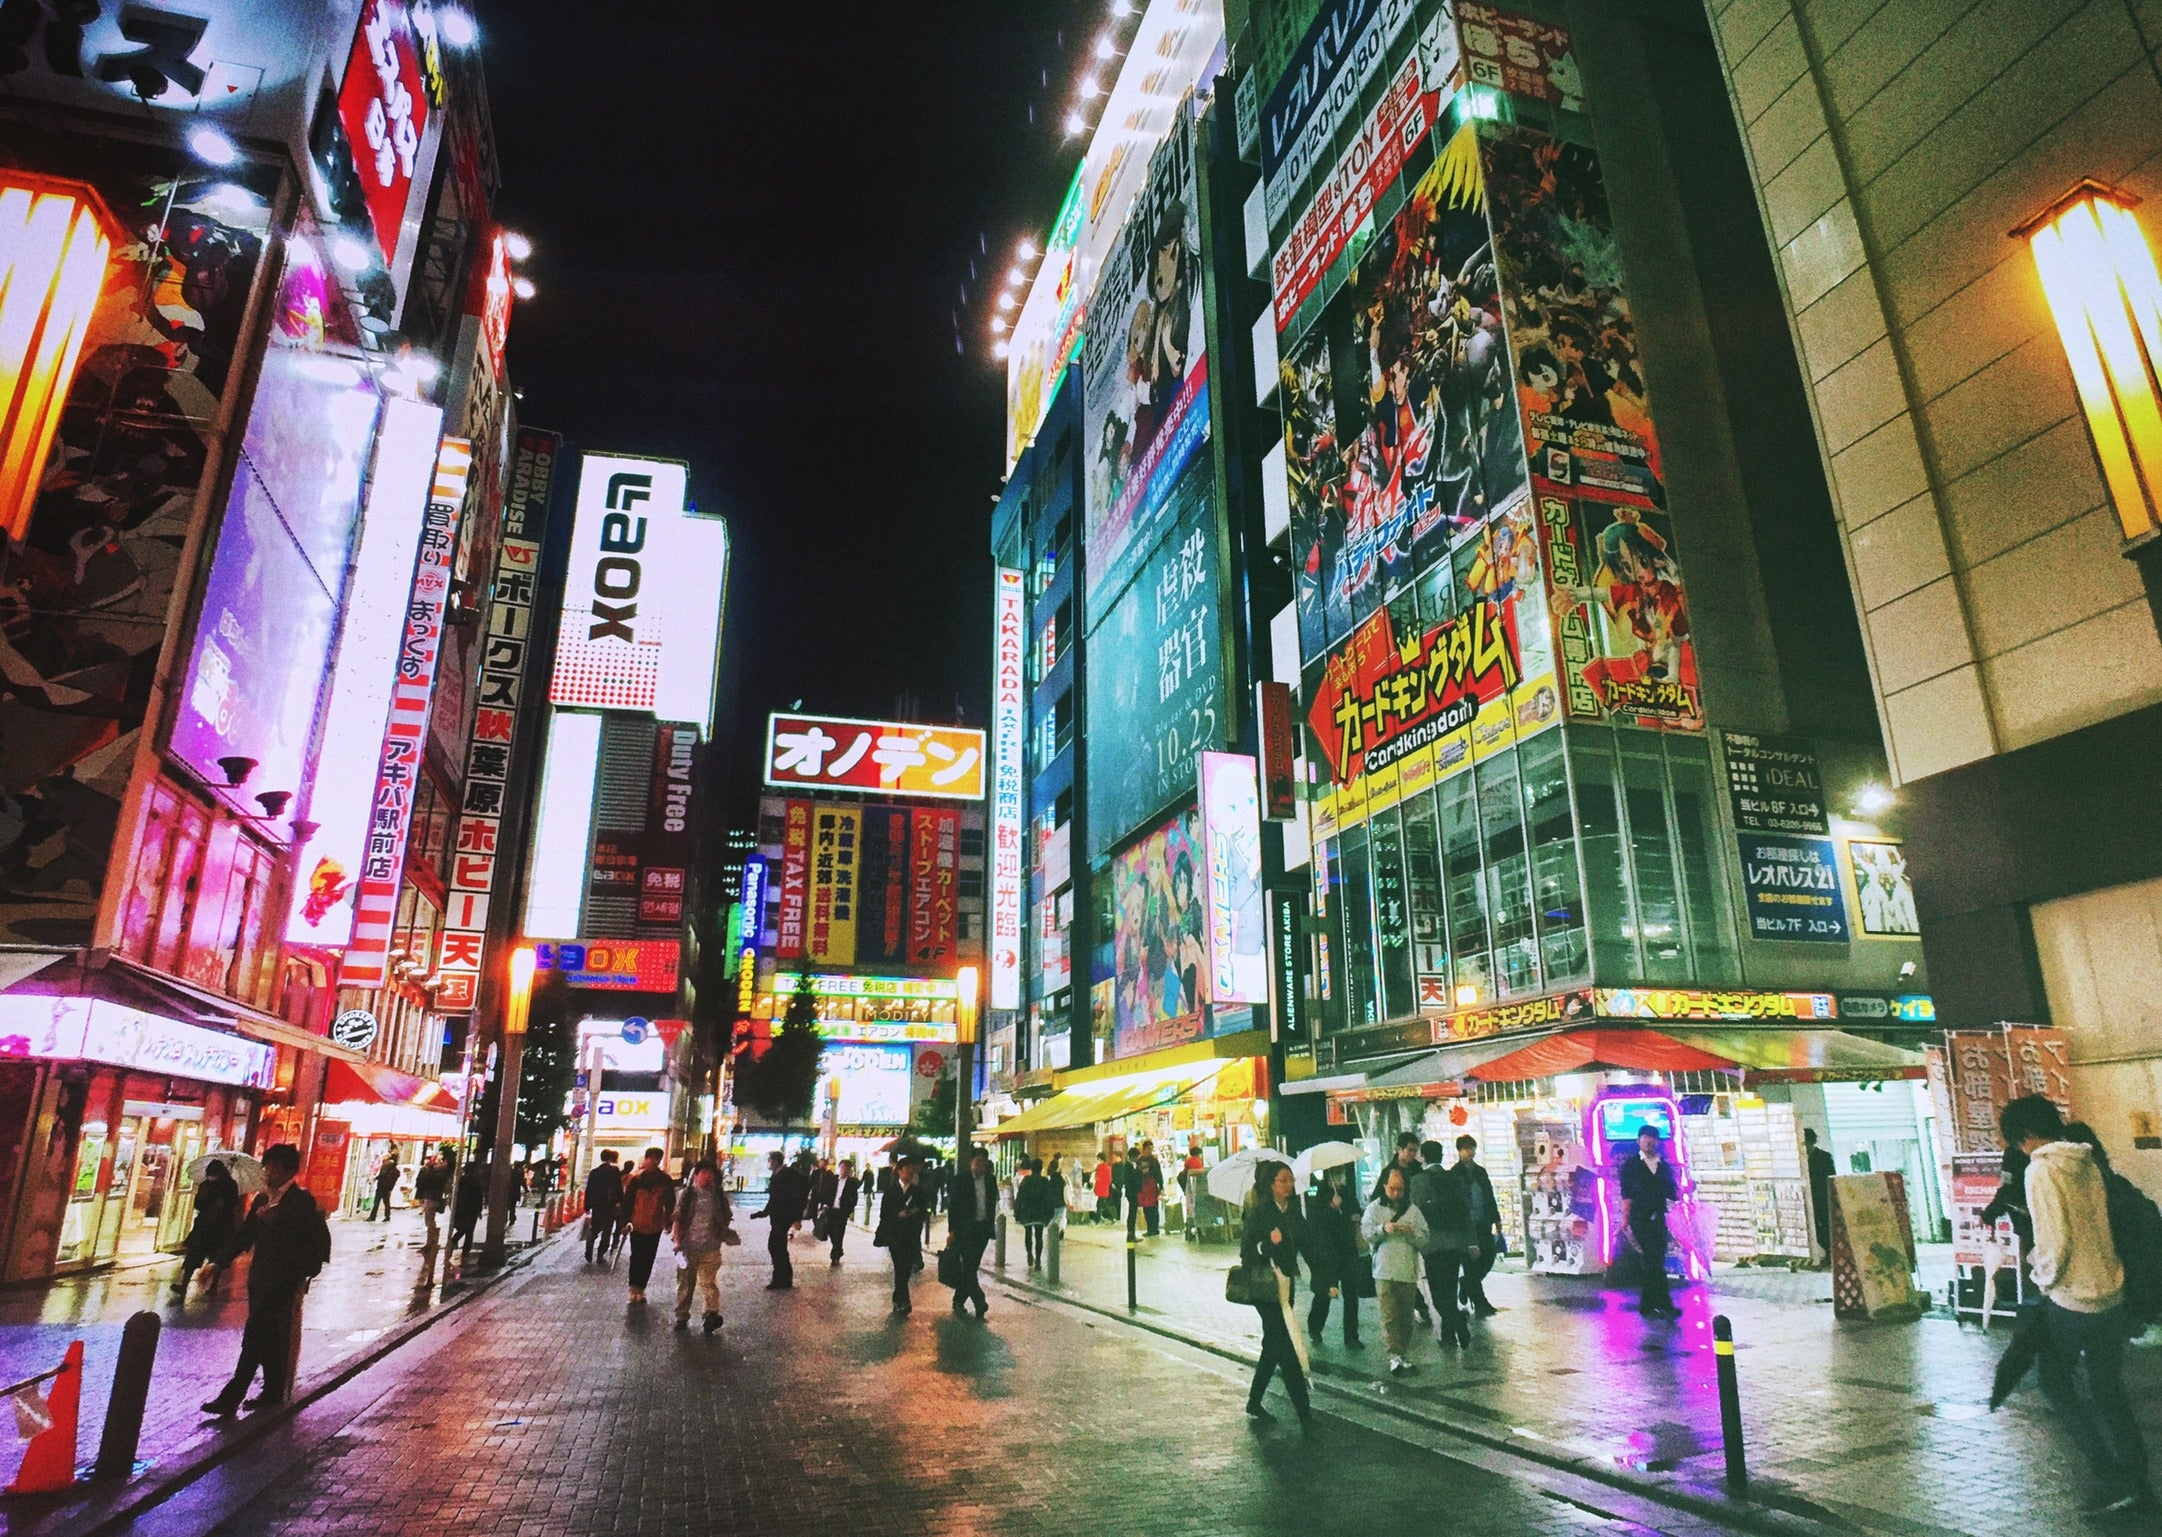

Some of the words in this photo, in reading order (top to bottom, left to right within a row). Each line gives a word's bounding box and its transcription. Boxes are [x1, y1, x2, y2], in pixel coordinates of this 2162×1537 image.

[1473, 62, 1498, 80] 6F
[1404, 103, 1423, 146] 6F
[423, 503, 455, 566] 買取り
[1542, 500, 1598, 717] カードゲム専門店
[1000, 598, 1020, 704] TAKARADA
[1335, 600, 1519, 783] カードキングダム
[666, 730, 698, 780] Duty
[775, 726, 979, 786] オノデン
[1157, 694, 1217, 777] 10.25
[366, 738, 413, 879] アキバ駅前店
[663, 784, 693, 832] Free
[787, 806, 808, 847] 免税
[1743, 815, 1761, 827] TEL
[646, 871, 682, 888] 免税
[785, 850, 806, 889] TAX
[1748, 863, 1836, 890] レオパレス21
[744, 863, 763, 938] Panasonic
[781, 894, 803, 949] FREE
[1211, 831, 1234, 996] GAMERS
[1282, 900, 1291, 932] AKIBA
[1756, 917, 1802, 933] 当ビル7F
[1808, 918, 1828, 933] 入口
[916, 945, 947, 960] 4F
[1284, 933, 1293, 966] STORE
[738, 947, 756, 1012] ONODEN
[818, 980, 858, 993] FREE
[1286, 967, 1296, 1030] ALIENWARE
[1468, 999, 1562, 1034] カードキングダム
[1670, 991, 1798, 1018] カードキングダム
[856, 1027, 901, 1038] エアコン
